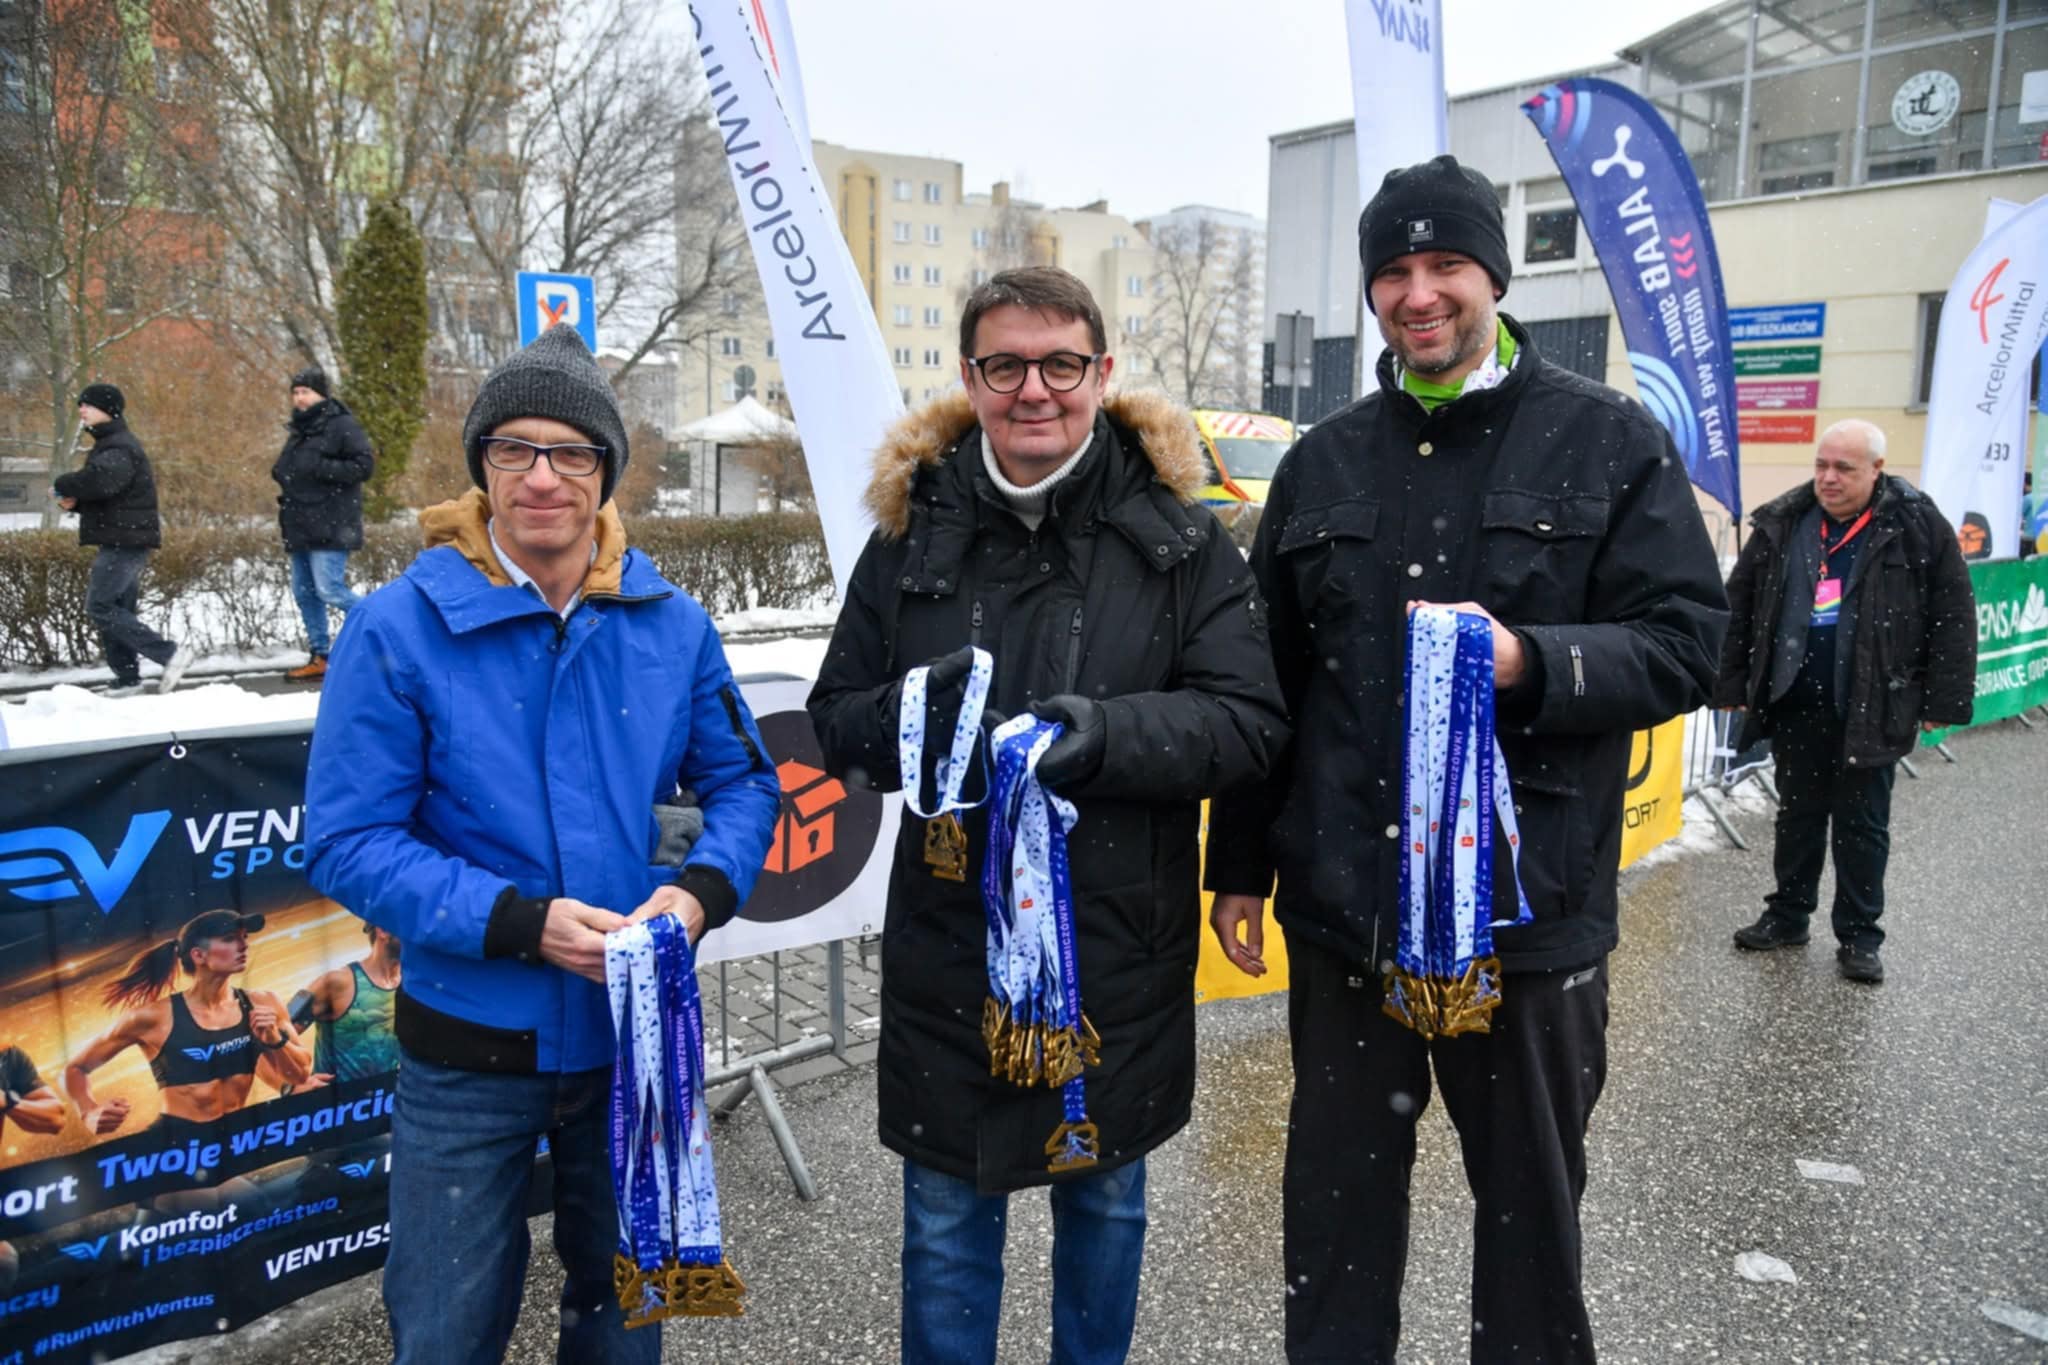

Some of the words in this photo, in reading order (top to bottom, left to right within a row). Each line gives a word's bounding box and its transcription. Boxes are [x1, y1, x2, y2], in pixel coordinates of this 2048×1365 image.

[536, 281, 580, 335] P
[1976, 281, 2037, 416] ArcelorMittal
[1976, 600, 2021, 641] ENSA
[1446, 729, 1464, 823] CHOMICZÓWKI
[1481, 769, 1490, 815] LUTEGO
[184, 804, 306, 854] VEN
[1058, 899, 1075, 984] CHOMICZÓWKI
[215, 1034, 251, 1051] VENTUS
[614, 1098, 624, 1139] LUTEGO
[0, 1174, 79, 1217] ort
[96, 1140, 223, 1189] Twoje
[119, 1203, 238, 1251] Komfort
[142, 1246, 150, 1268] i
[157, 1197, 338, 1263] bezpieczeństwo
[0, 1284, 61, 1317] czy
[33, 1293, 216, 1357] #RunWithVentus
